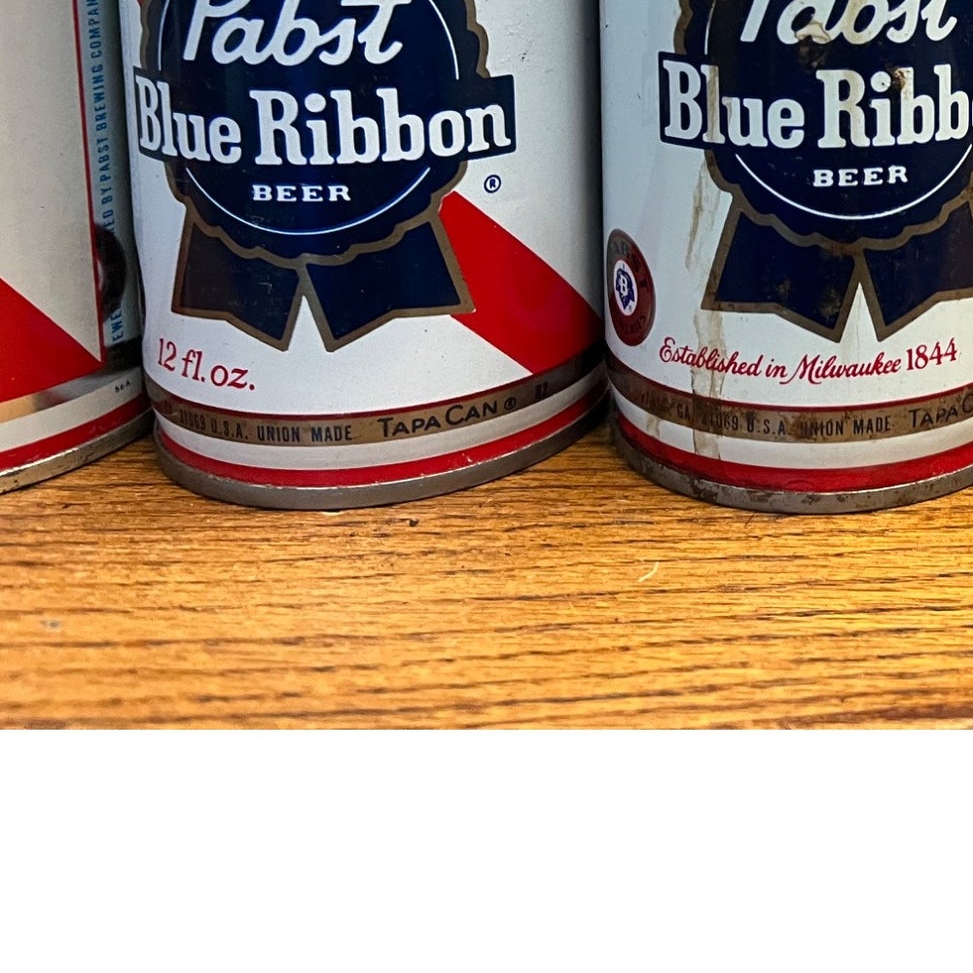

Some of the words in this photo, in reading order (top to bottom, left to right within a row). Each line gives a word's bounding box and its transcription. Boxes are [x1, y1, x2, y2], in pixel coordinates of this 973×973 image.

[92, 64, 107, 129] BREWING
[135, 74, 243, 165] Blue
[249, 87, 512, 166] Ribbon
[662, 59, 806, 149] Blue
[96, 136, 112, 183] PABST
[812, 165, 909, 187] BEER
[101, 186, 114, 207] BY
[252, 183, 352, 203] BEER
[157, 337, 179, 372] 12
[181, 349, 207, 384] fl.
[210, 366, 256, 391] oz.
[659, 336, 762, 377] Established
[765, 356, 787, 380] in
[779, 351, 902, 385] Milwaukee
[906, 337, 958, 372] 1844
[211, 418, 249, 440] U.S.A.
[257, 425, 300, 443] UNION
[311, 424, 353, 443] MADE
[801, 422, 844, 437] UNION
[853, 415, 892, 435] MADE
